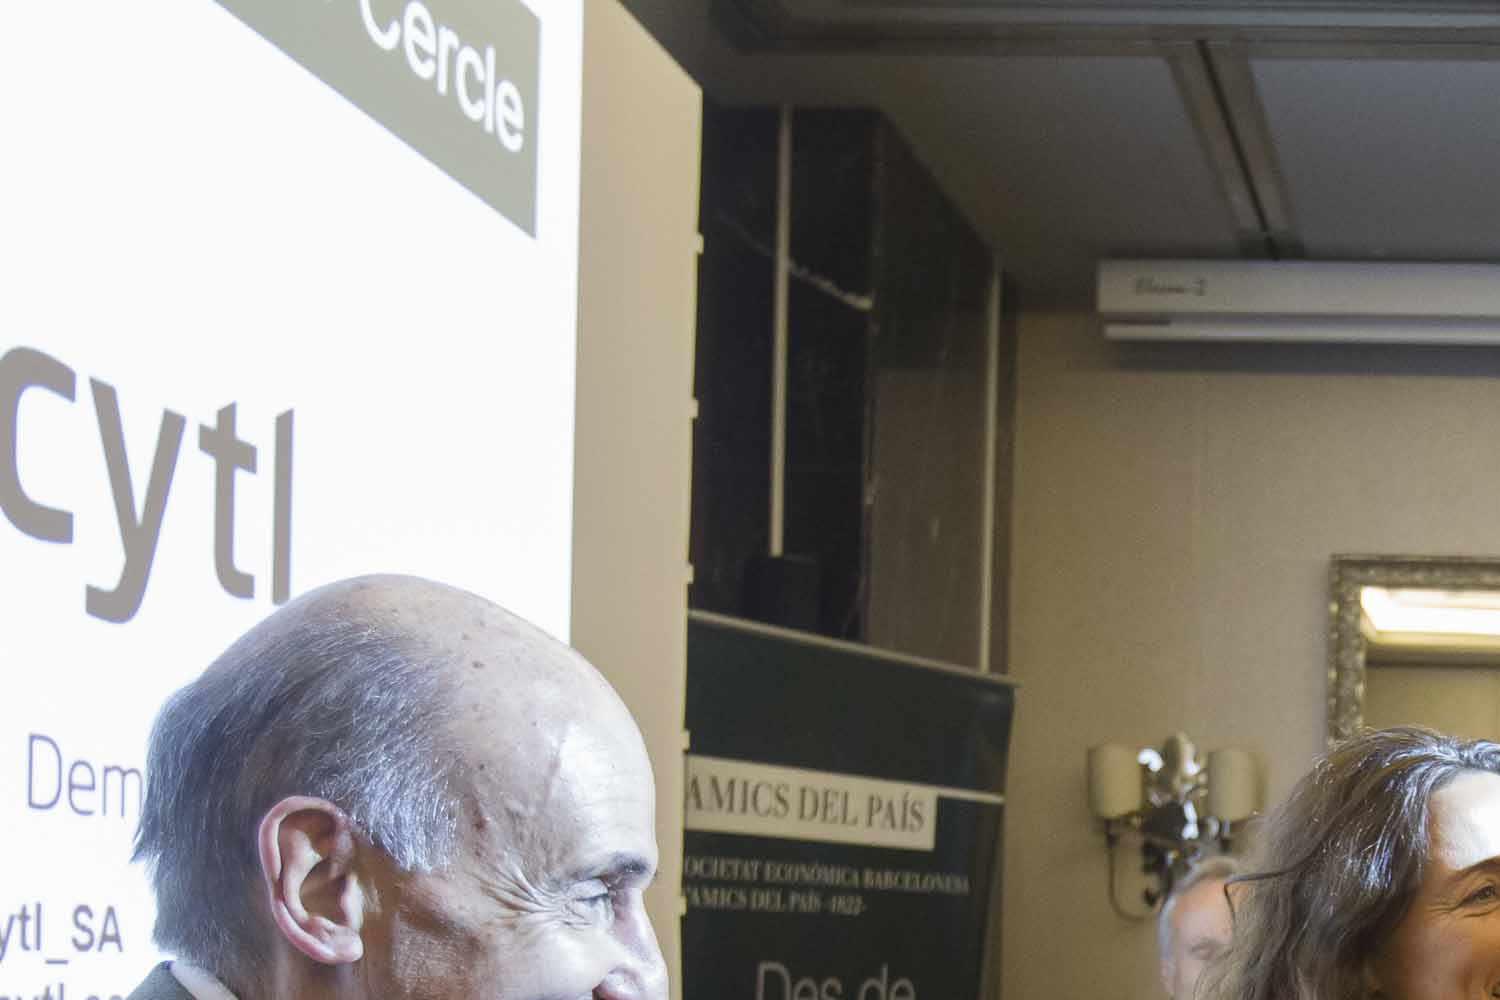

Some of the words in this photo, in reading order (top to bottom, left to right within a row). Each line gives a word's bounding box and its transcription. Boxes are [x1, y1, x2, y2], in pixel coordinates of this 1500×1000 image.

[358, 0, 525, 153] Cercle
[0, 346, 295, 625] cytl
[27, 732, 144, 818] Dem
[685, 774, 790, 819] AMICS
[798, 786, 858, 827] DEL
[866, 790, 927, 833] PAÍS
[749, 887, 787, 912] DEL
